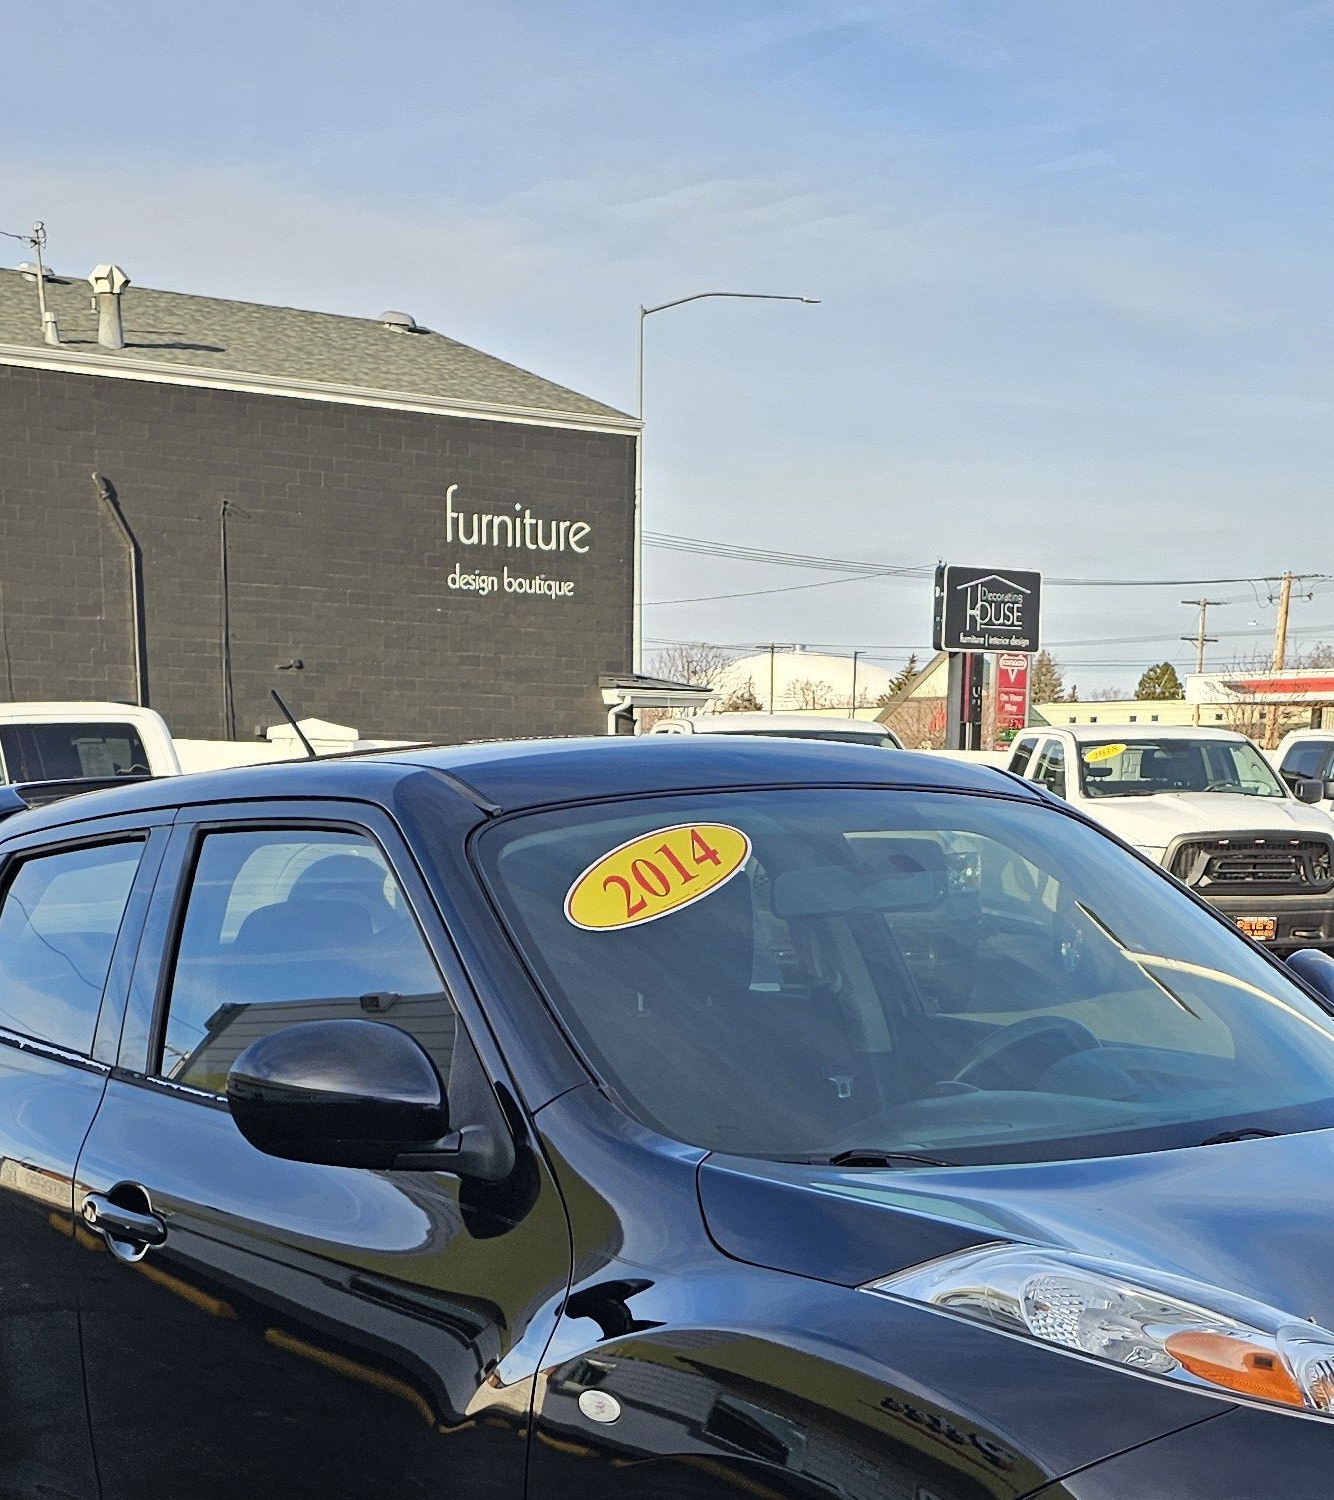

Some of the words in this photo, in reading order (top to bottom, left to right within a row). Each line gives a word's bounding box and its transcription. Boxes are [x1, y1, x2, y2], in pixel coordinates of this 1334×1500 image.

[446, 484, 591, 553] furniture
[447, 563, 498, 595] design
[503, 566, 575, 599] boutique
[982, 586, 1023, 604] Decorating
[966, 583, 1023, 631] HOUSE
[603, 829, 721, 918] 2014
